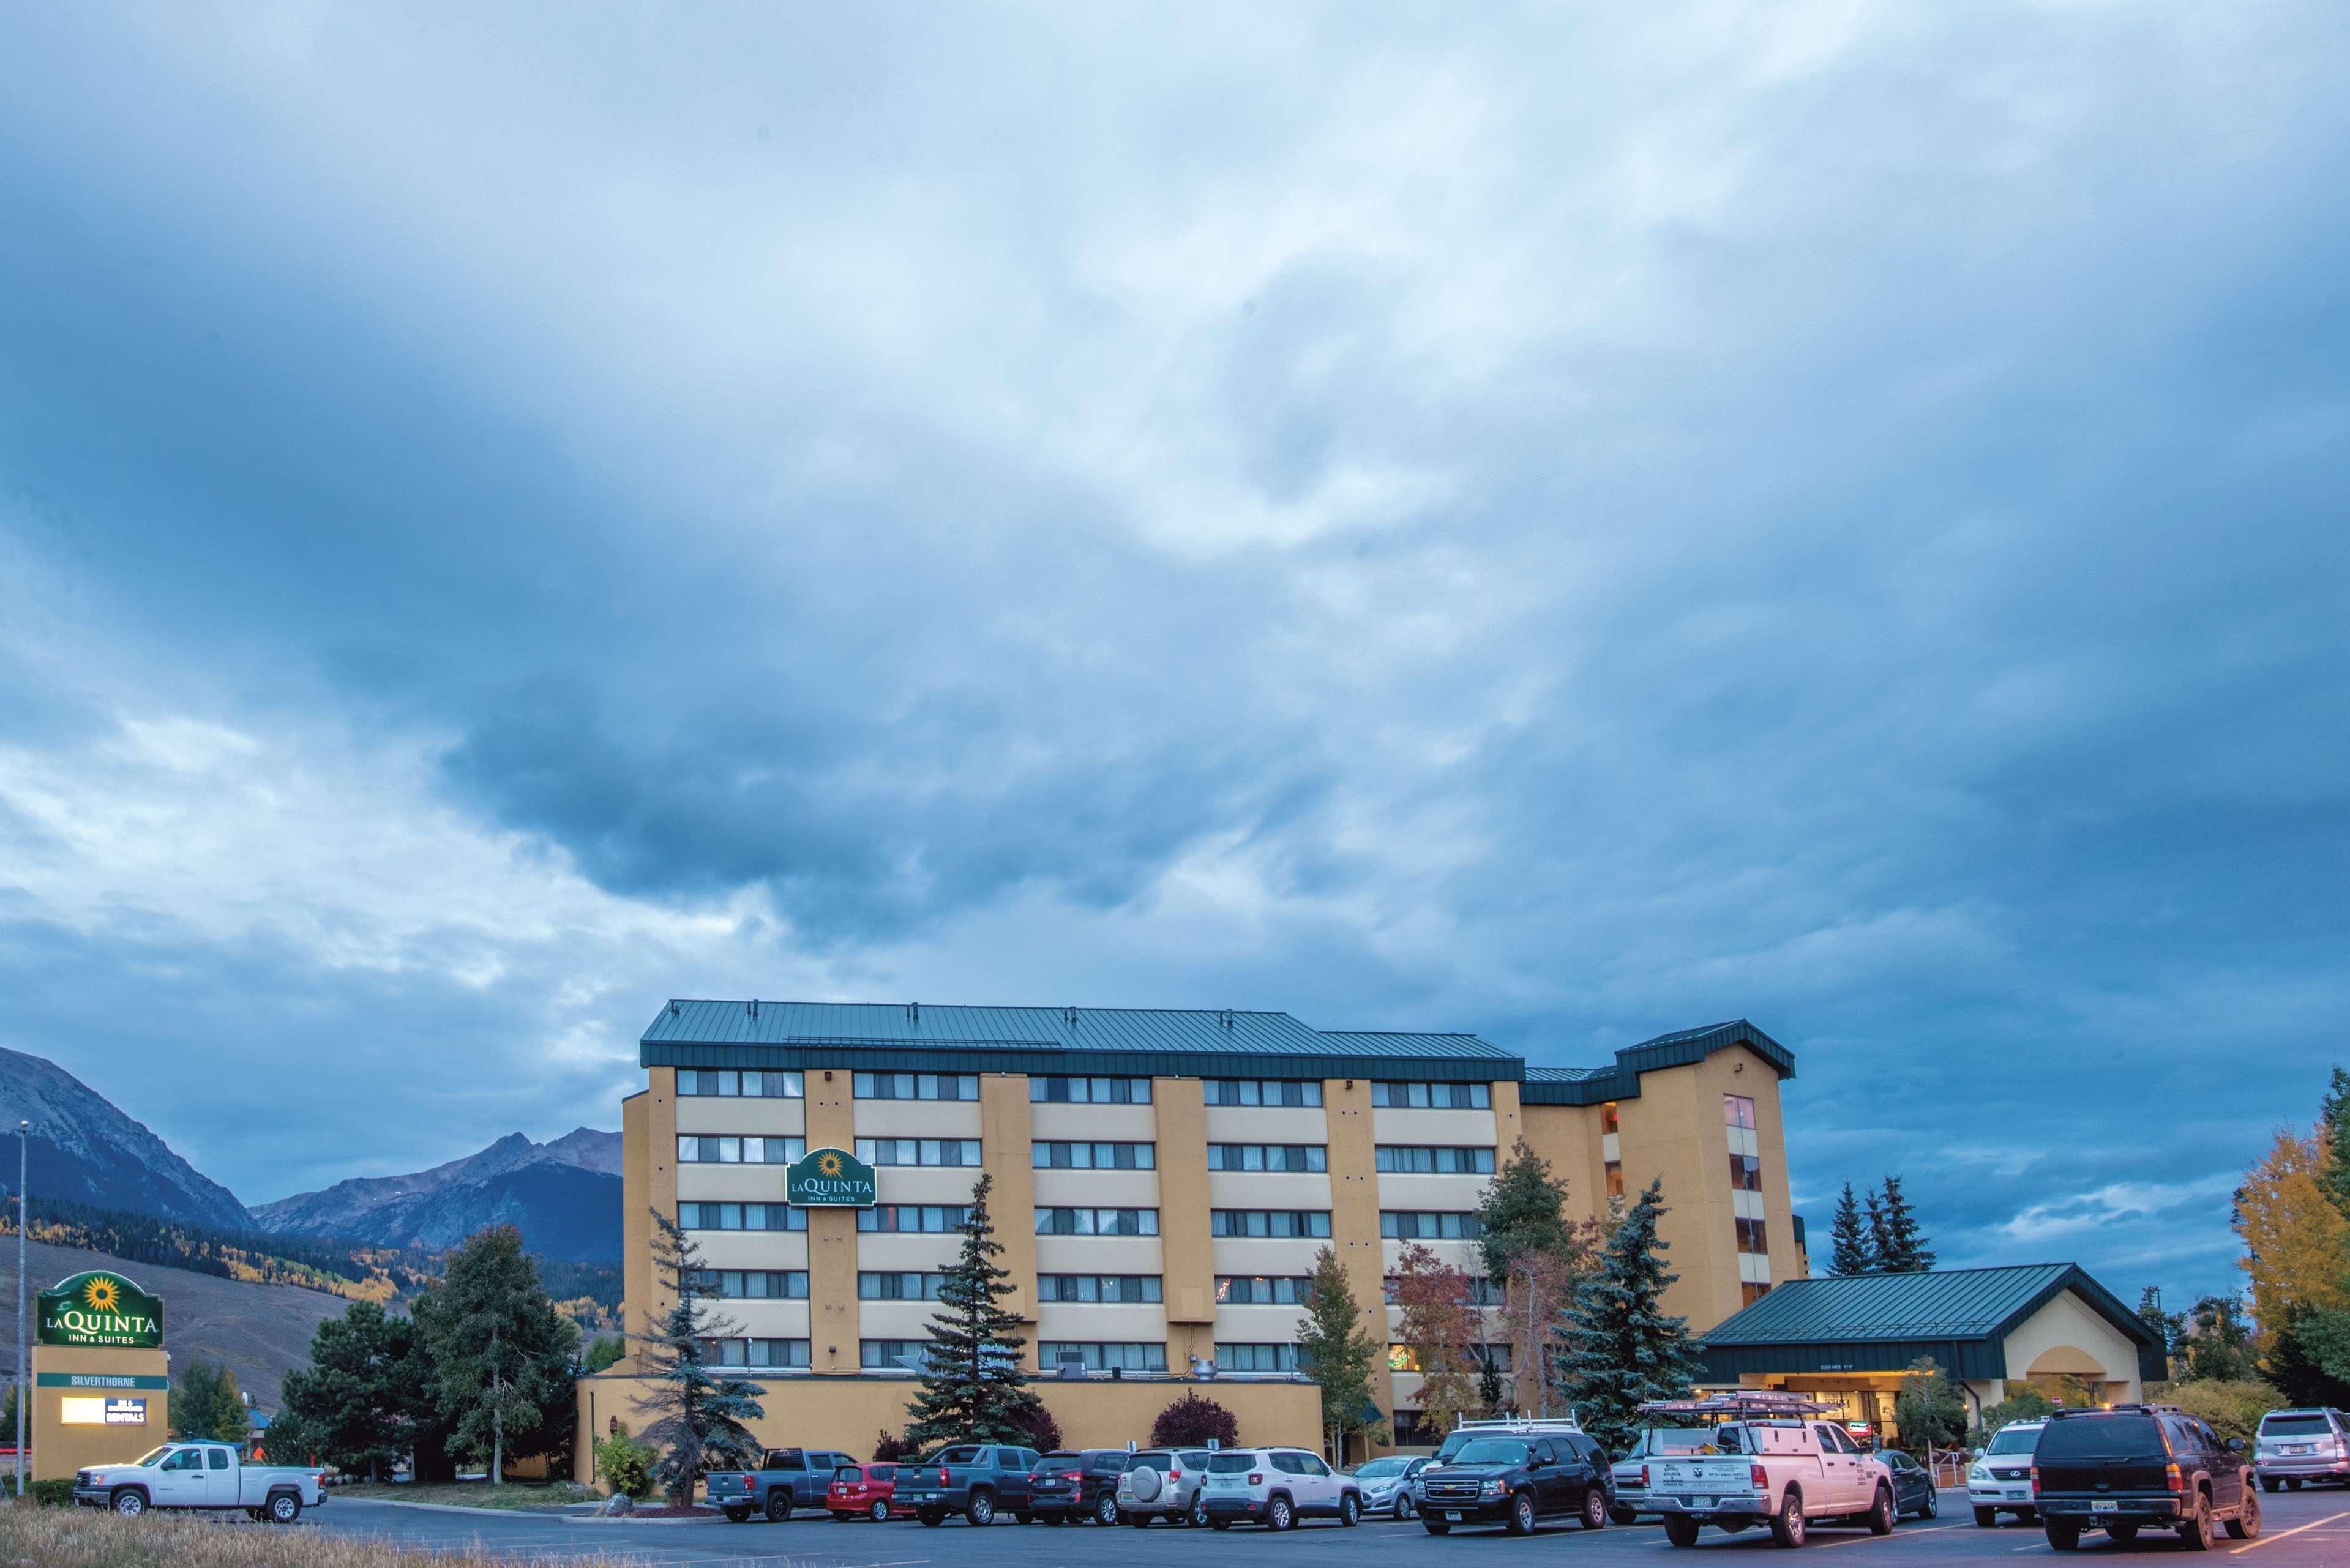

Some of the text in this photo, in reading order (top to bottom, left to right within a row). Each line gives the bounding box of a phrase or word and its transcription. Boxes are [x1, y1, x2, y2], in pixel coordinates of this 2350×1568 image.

[804, 1178, 872, 1195] QUINTA
[46, 1311, 158, 1334] LA QUINTA
[98, 1335, 135, 1344] SUITES
[71, 1376, 135, 1387] SILVERTHORNE
